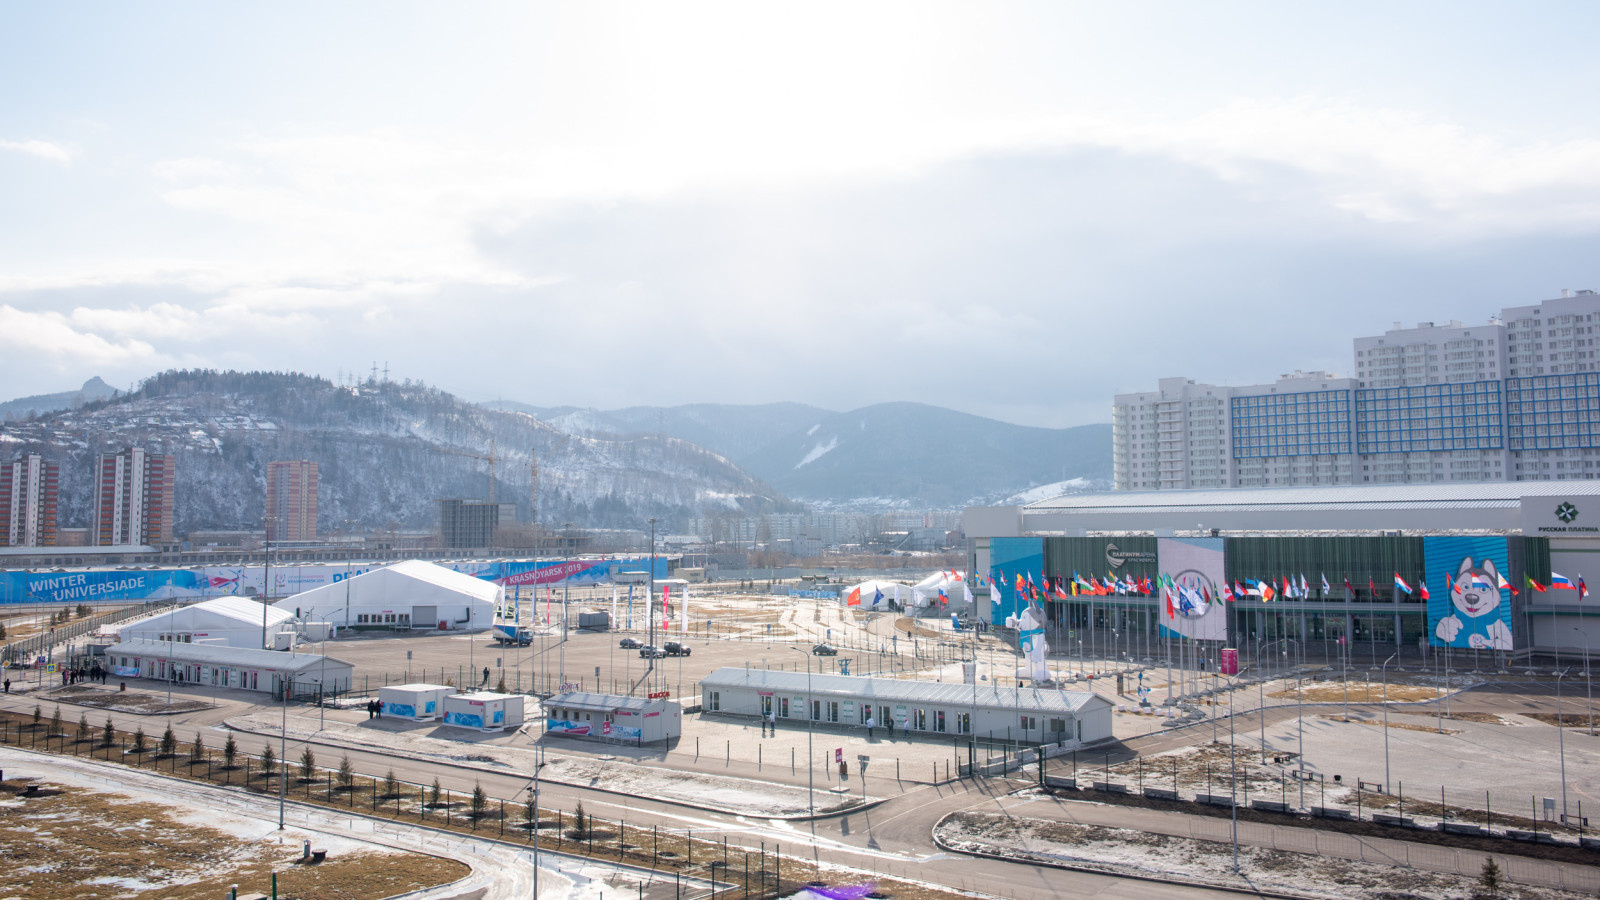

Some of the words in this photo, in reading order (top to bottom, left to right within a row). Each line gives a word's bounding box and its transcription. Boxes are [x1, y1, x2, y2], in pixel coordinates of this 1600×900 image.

[30, 574, 86, 592] WINTER
[510, 568, 563, 584] KRASNOYARSK
[54, 577, 145, 600] UNIVERSIADE
